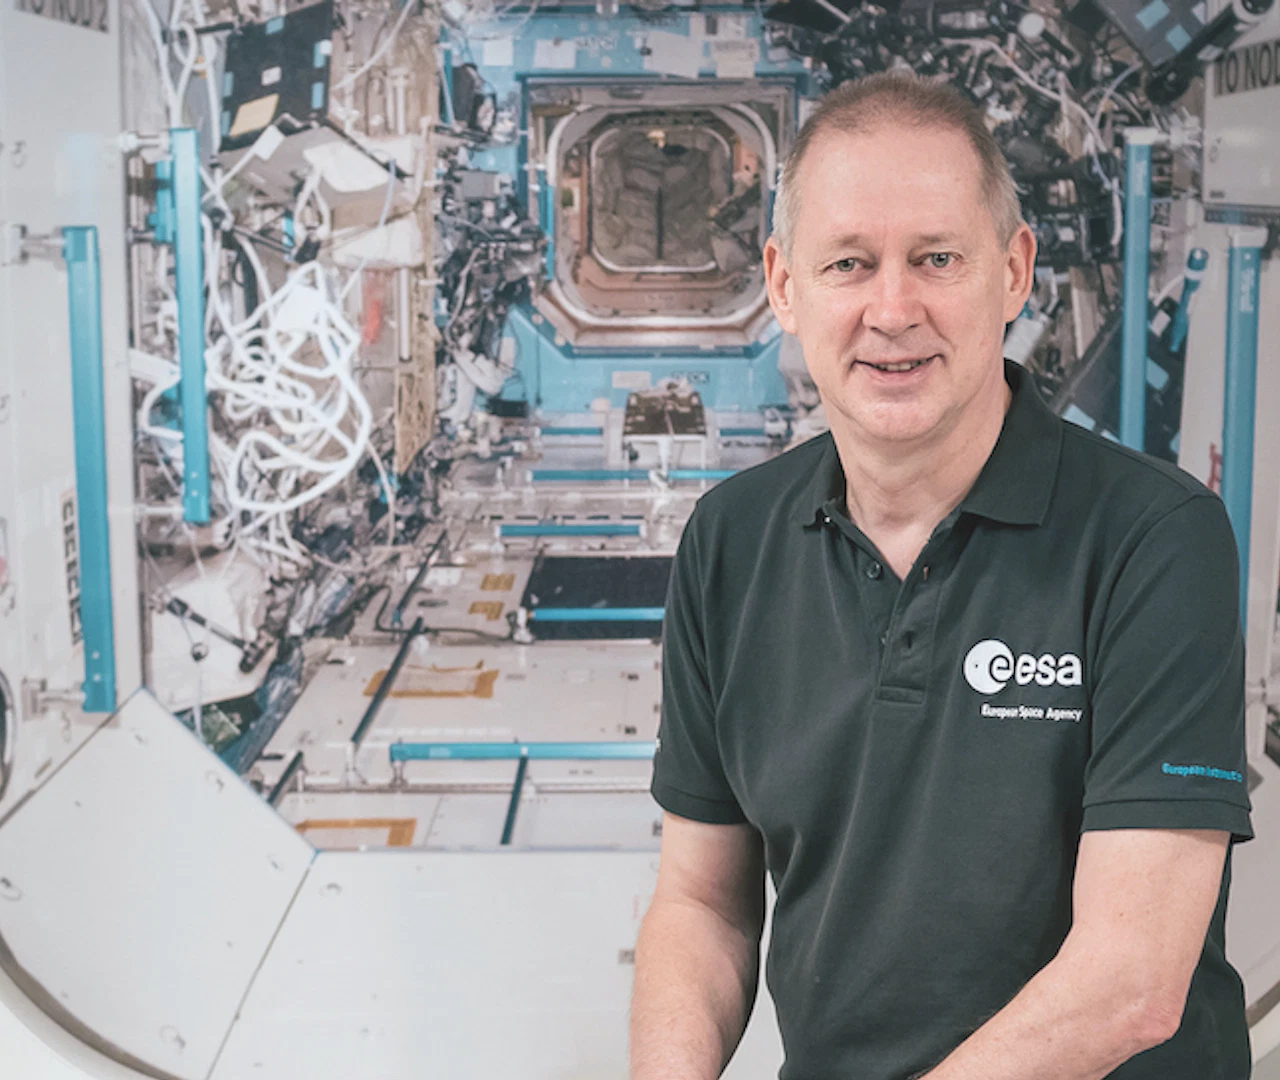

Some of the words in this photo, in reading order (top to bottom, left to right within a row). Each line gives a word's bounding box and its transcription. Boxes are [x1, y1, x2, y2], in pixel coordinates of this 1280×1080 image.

[1015, 653, 1082, 686] esa
[981, 703, 1018, 719] European
[1019, 705, 1044, 719] Space
[1046, 707, 1082, 721] Agency
[1162, 762, 1205, 776] European
